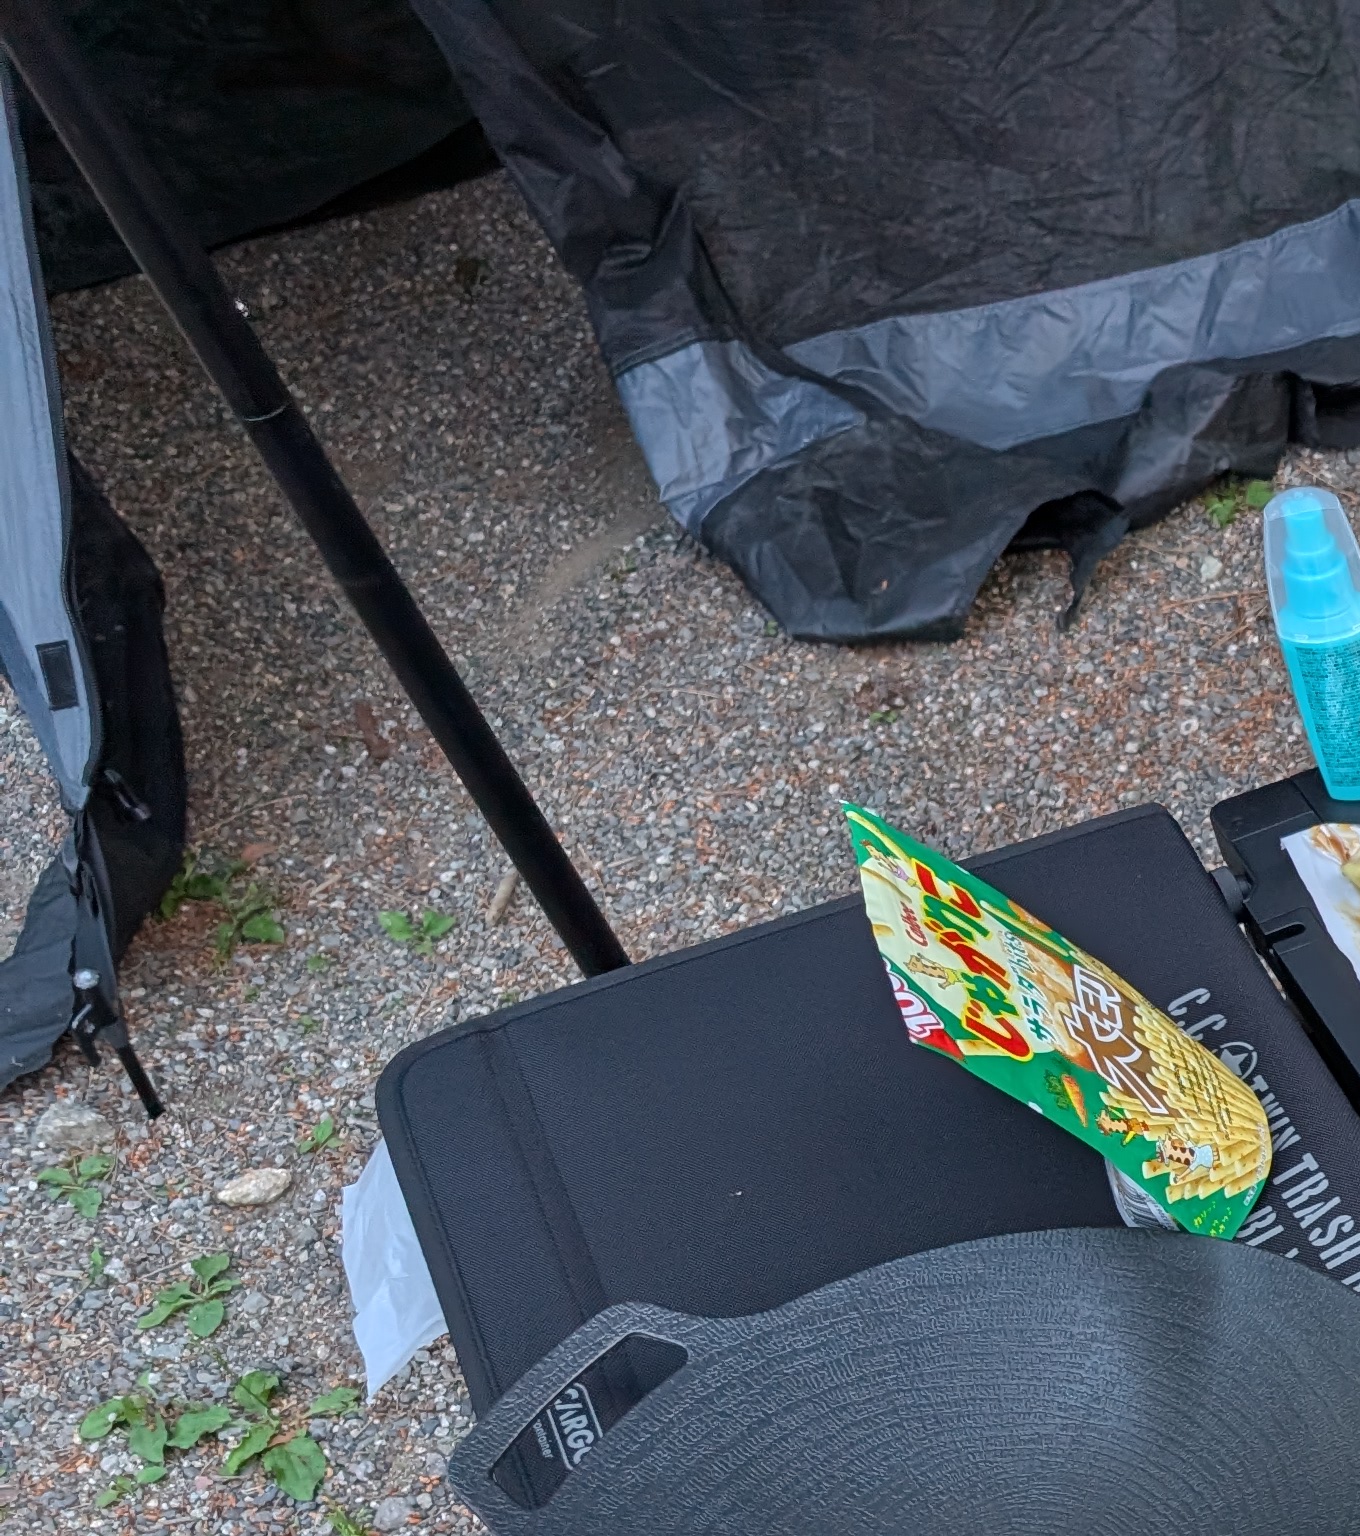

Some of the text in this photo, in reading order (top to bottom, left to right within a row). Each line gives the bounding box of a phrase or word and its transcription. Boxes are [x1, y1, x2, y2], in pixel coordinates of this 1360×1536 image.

[912, 857, 1034, 1062] じゃがりこ
